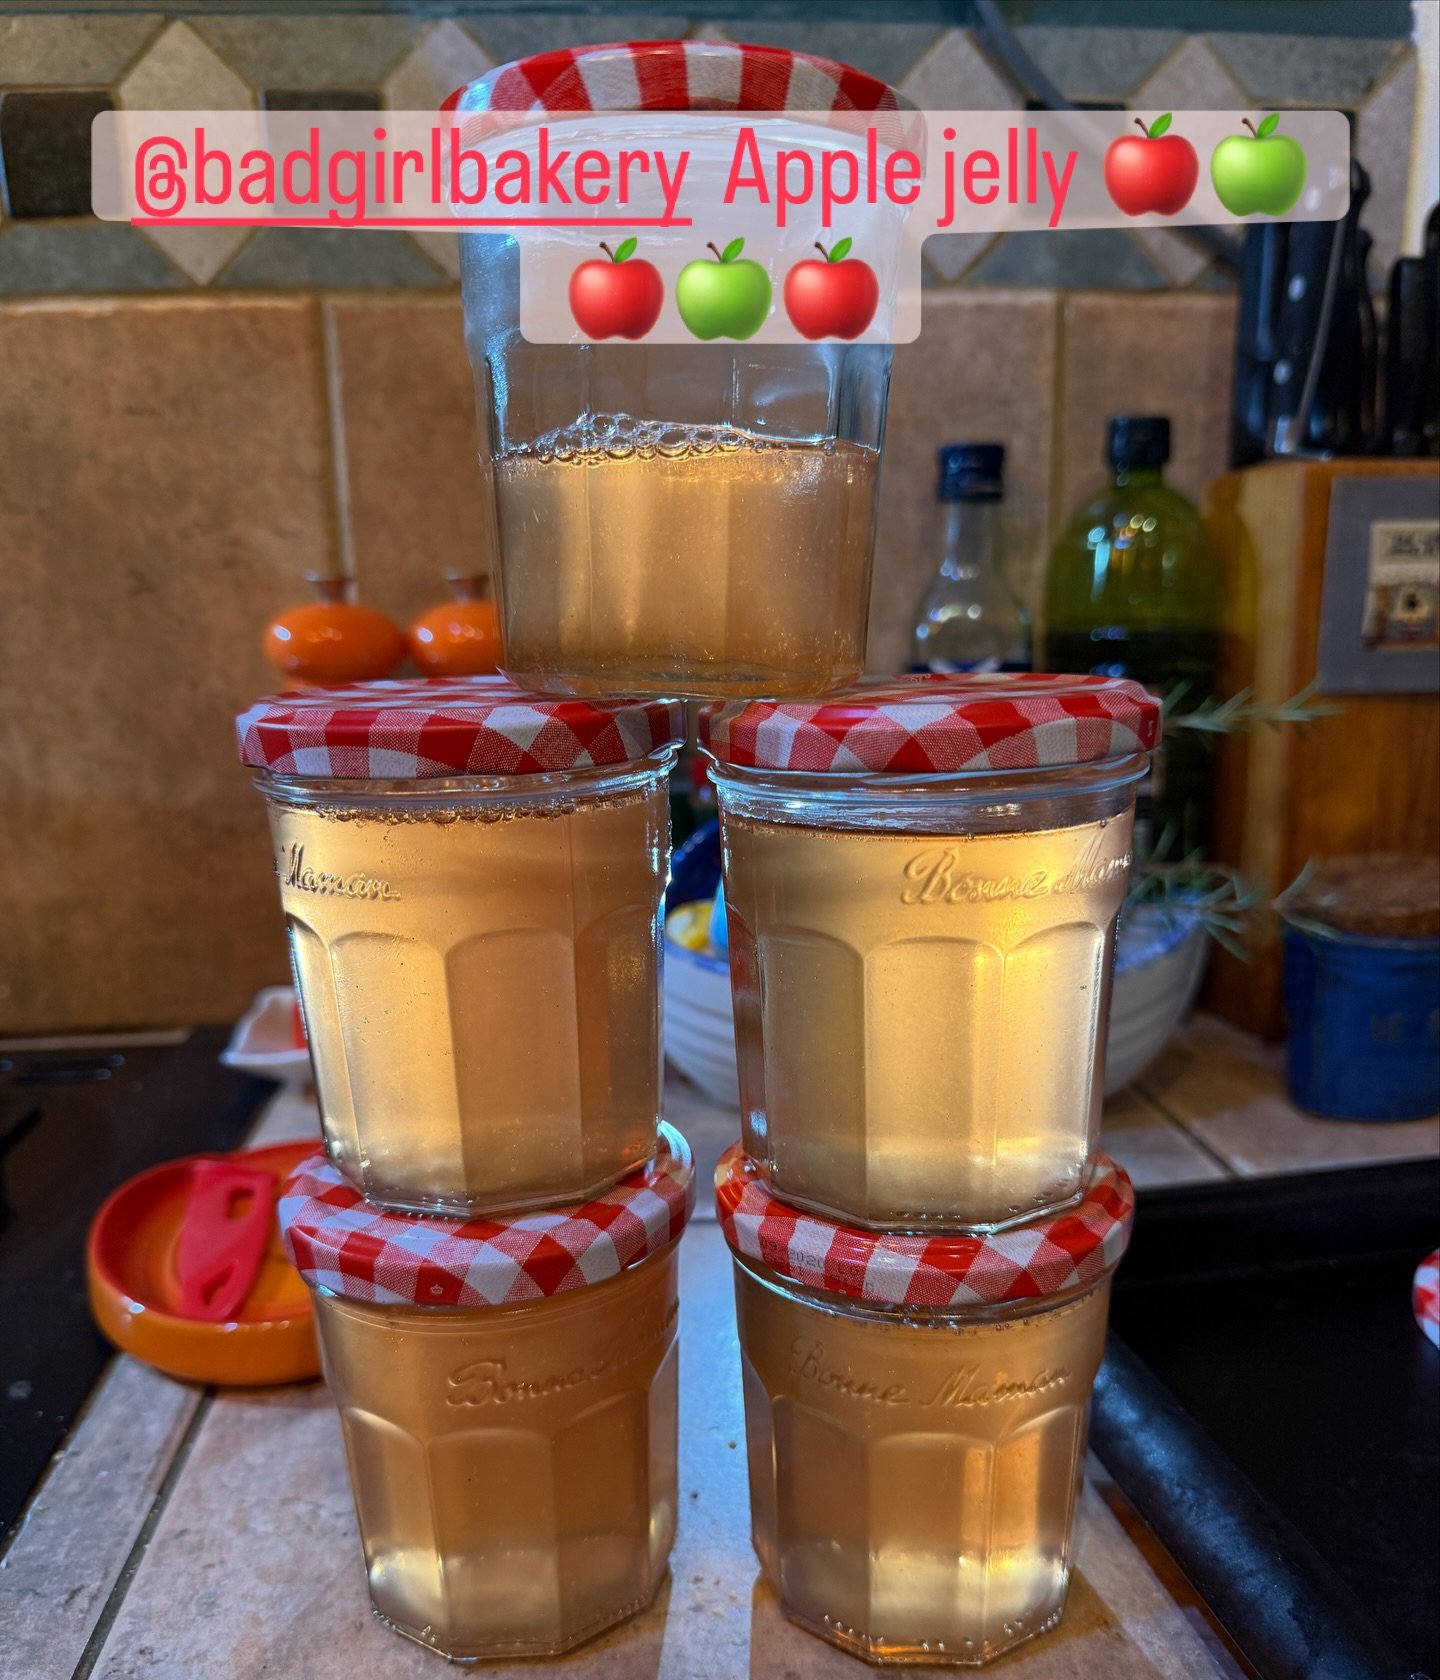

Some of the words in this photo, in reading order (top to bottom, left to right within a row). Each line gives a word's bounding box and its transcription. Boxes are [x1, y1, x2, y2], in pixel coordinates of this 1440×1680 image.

[901, 847, 1050, 904] Bonne
[791, 1335, 911, 1406] Bonne
[919, 1362, 1072, 1408] Maman
